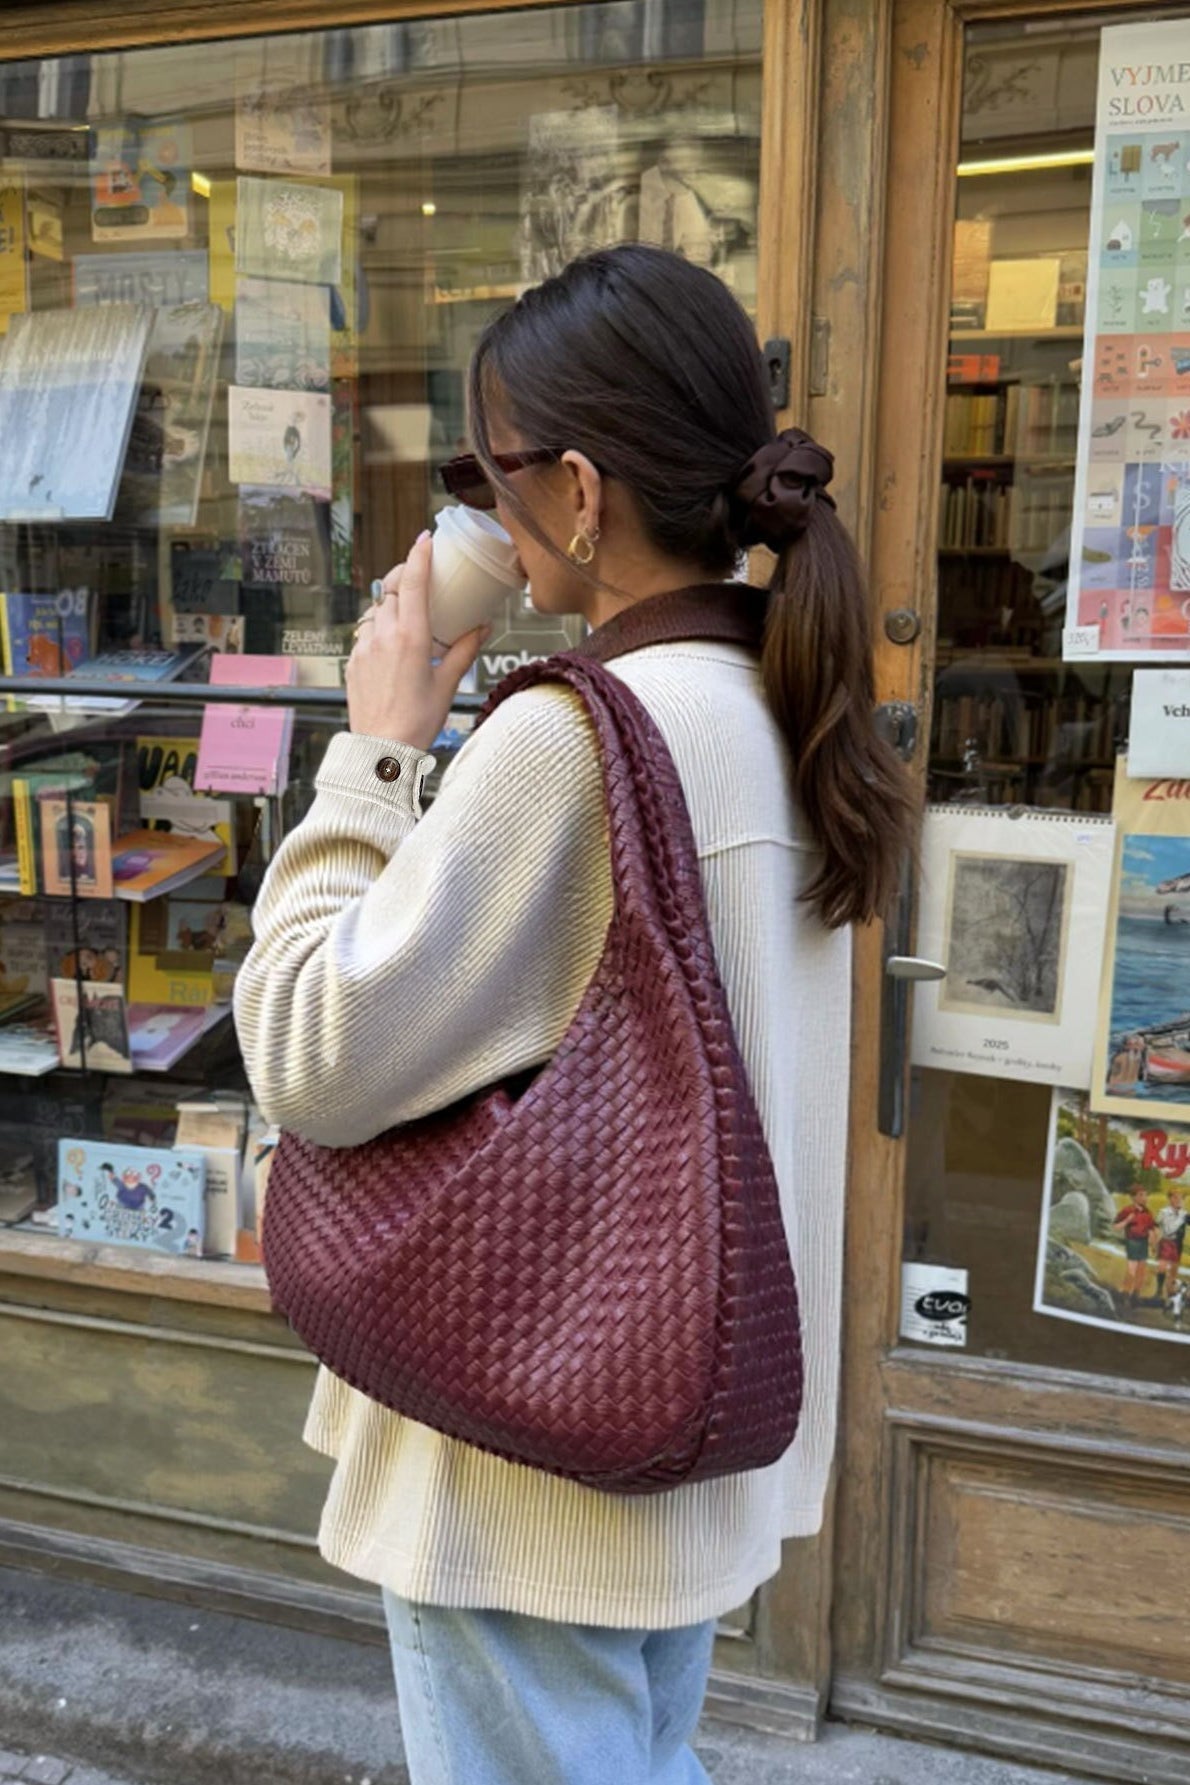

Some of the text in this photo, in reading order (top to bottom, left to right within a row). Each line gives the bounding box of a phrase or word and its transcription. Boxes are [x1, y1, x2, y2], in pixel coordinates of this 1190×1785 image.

[1108, 94, 1185, 116] SLOVA
[982, 1038, 1010, 1051] 2025
[158, 1207, 175, 1230] 2
